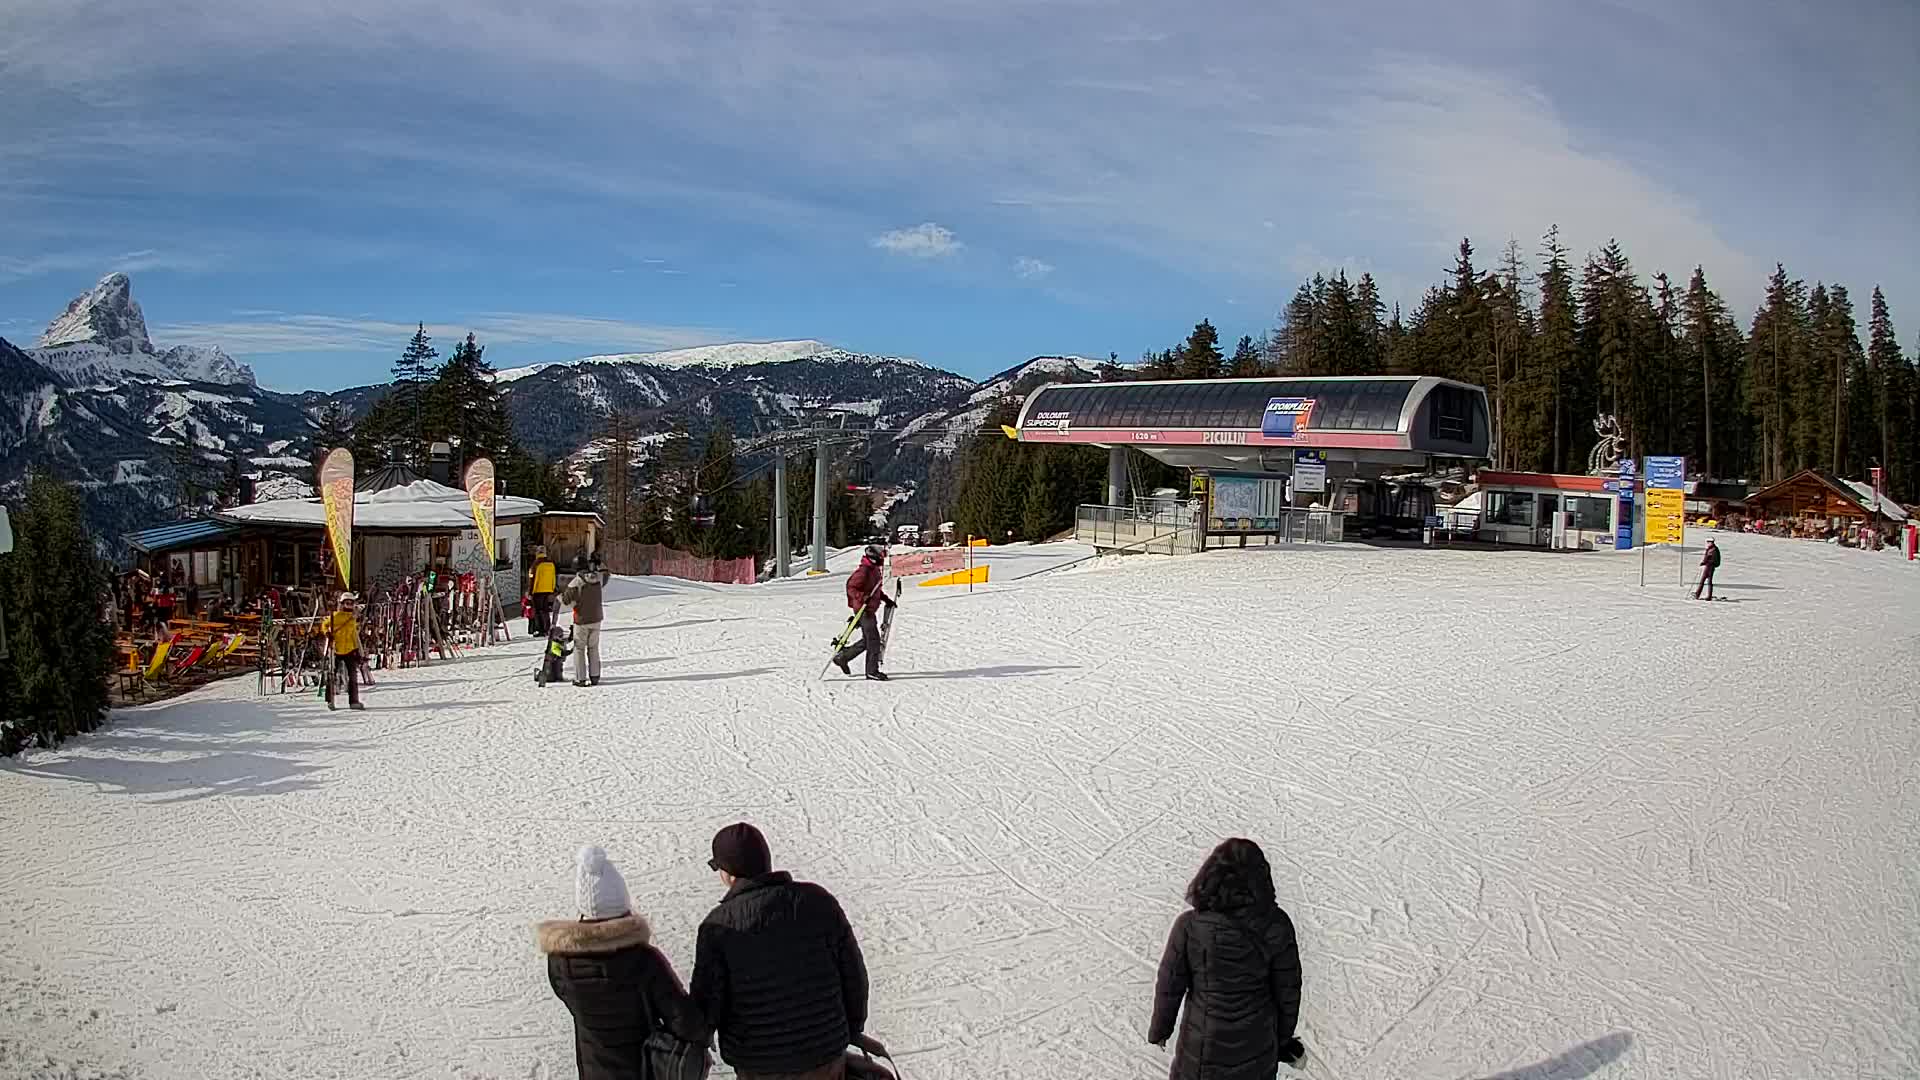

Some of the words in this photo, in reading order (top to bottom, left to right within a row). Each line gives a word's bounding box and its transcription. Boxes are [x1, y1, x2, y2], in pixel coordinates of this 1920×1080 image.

[1037, 411, 1069, 419] DOLOMITI
[1026, 419, 1058, 427] SUPERSKI
[1203, 432, 1245, 445] PICULIN
